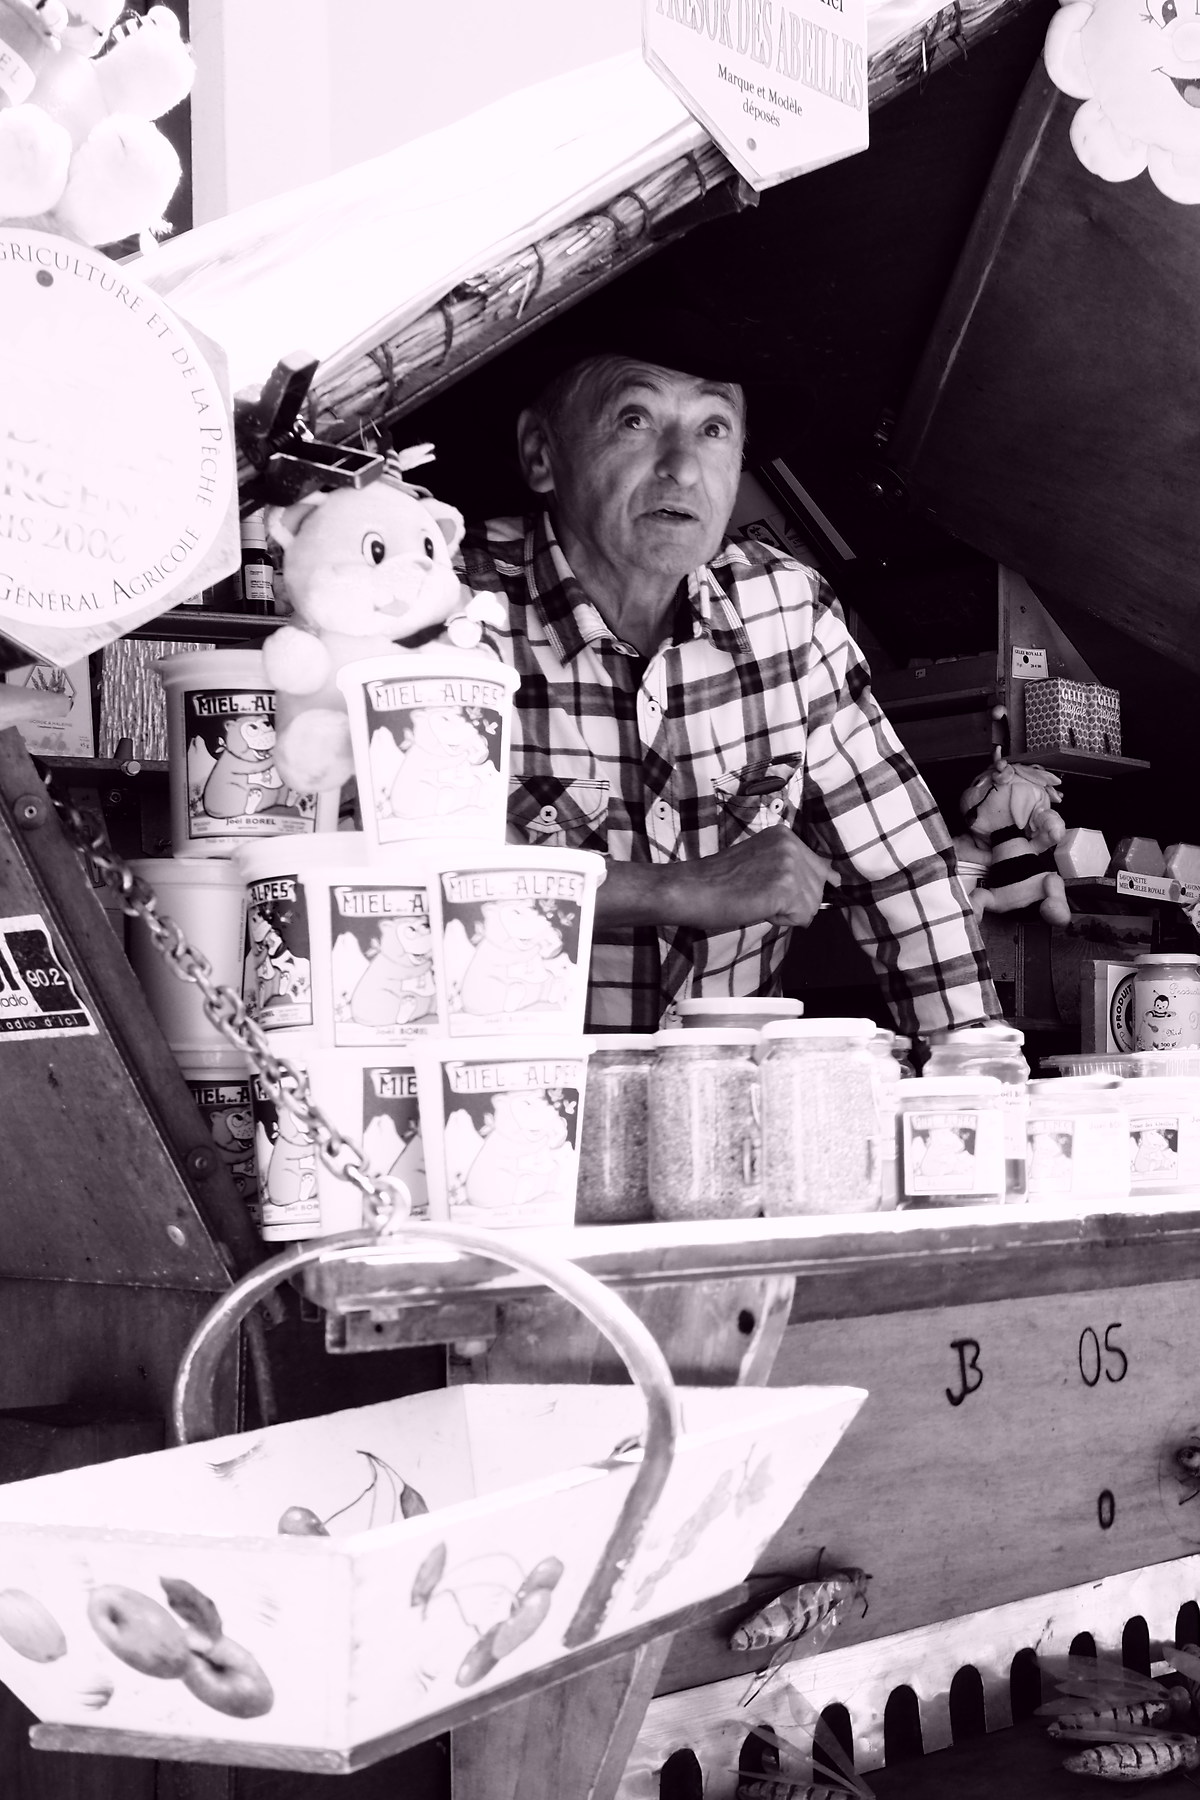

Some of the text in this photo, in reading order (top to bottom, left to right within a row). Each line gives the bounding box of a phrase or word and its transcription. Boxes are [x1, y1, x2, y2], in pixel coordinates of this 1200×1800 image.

[776, 6, 864, 112] ABEILLES
[717, 62, 803, 117] Marque et Modèle
[742, 98, 780, 128] déposés
[146, 312, 174, 341] ET
[171, 346, 198, 381] DE
[190, 387, 210, 415] LA
[195, 426, 224, 507] PÊCHE
[111, 525, 201, 606] AGRICOLE
[196, 696, 239, 715] MIEL
[375, 683, 499, 708] MIEL ALPES
[245, 818, 277, 826] BOREL
[448, 876, 576, 900] MIEL ALPES
[1148, 887, 1166, 896] ROYALE
[343, 892, 392, 914] MIEL
[26, 968, 65, 988] 90.2
[1116, 983, 1133, 1030] PRODUIT
[379, 1075, 418, 1097] MIE
[455, 1067, 505, 1090] MIEL
[1078, 1322, 1128, 1387] 05
